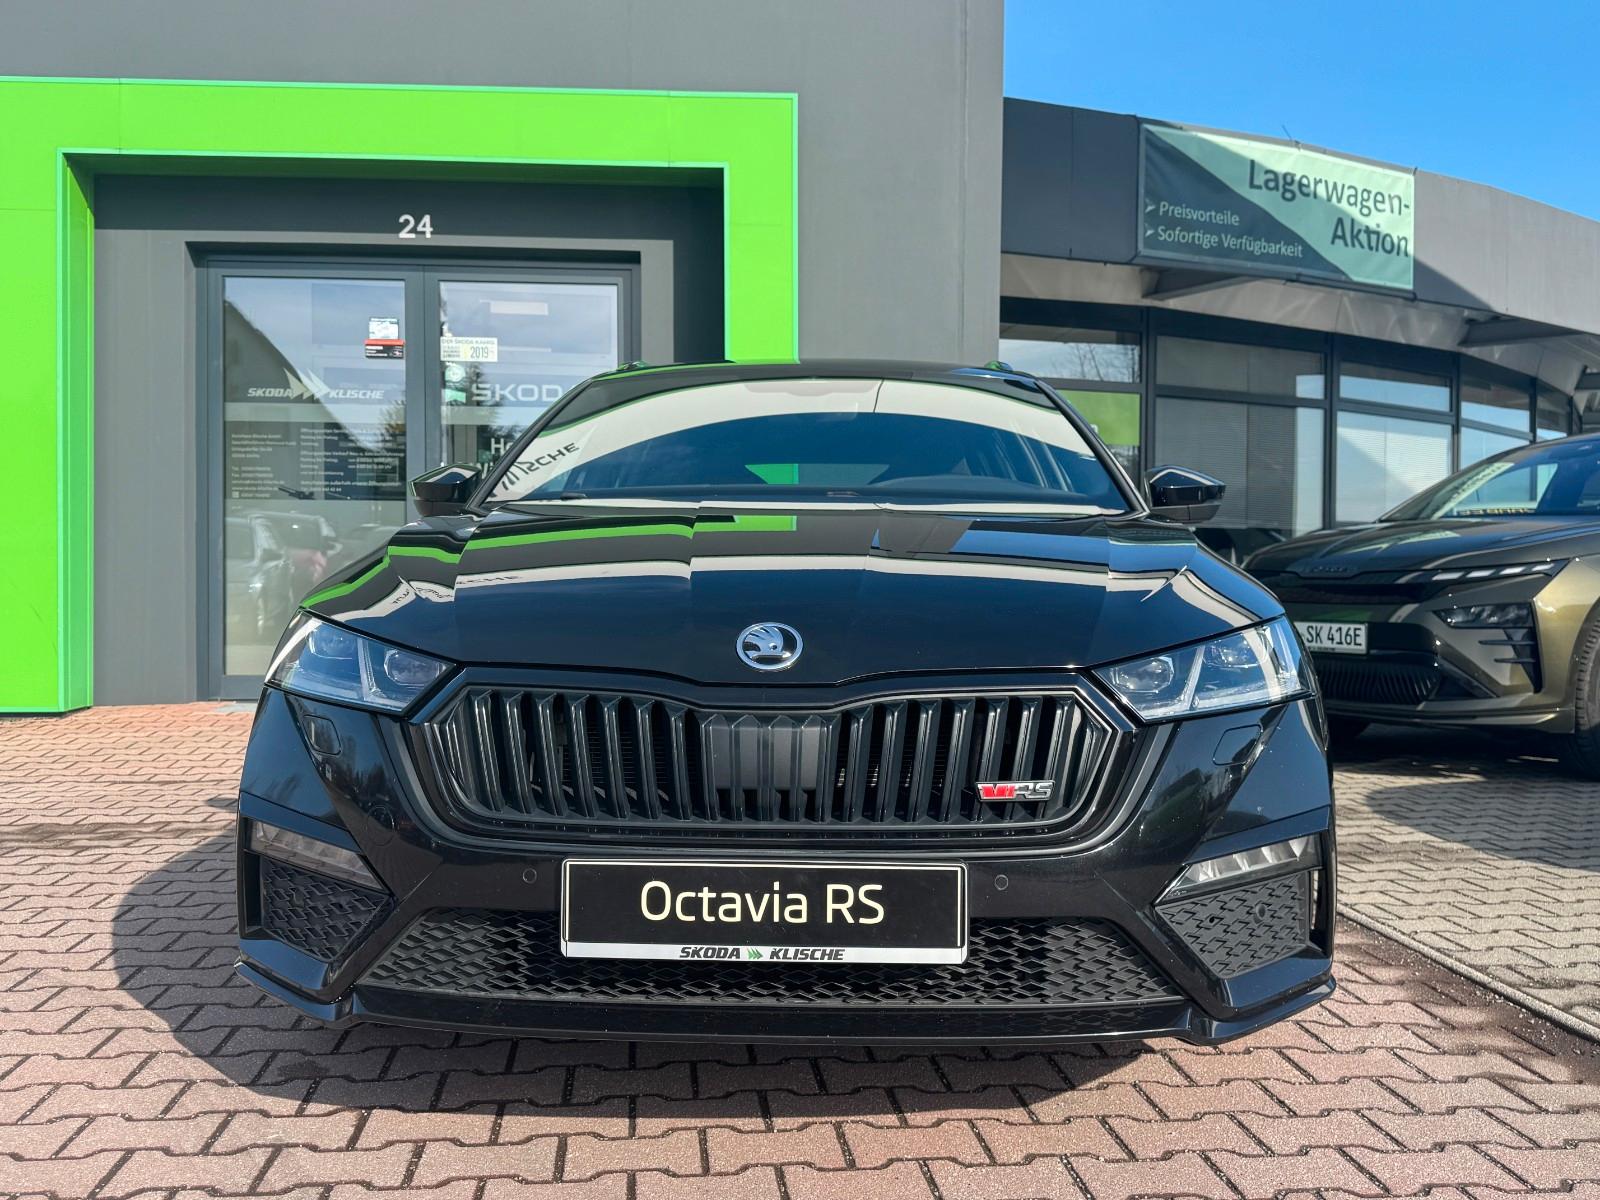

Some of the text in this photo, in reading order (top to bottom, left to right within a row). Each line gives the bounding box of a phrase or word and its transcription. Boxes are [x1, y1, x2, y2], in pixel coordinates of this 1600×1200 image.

[1248, 159, 1410, 217] Lagerwagen-
[398, 213, 434, 239] 24
[1159, 201, 1240, 226] Preisvorteile
[1157, 225, 1304, 258] Sofortige Verfügbarkeit
[1330, 216, 1409, 257] Aktion
[470, 346, 489, 359] 2019
[328, 388, 385, 399] KLISCHE
[471, 383, 576, 402] SKOD
[1306, 625, 1362, 647] SK 416E
[640, 880, 885, 925] Octavia RS
[679, 946, 846, 961] SKODA KLISCHE
